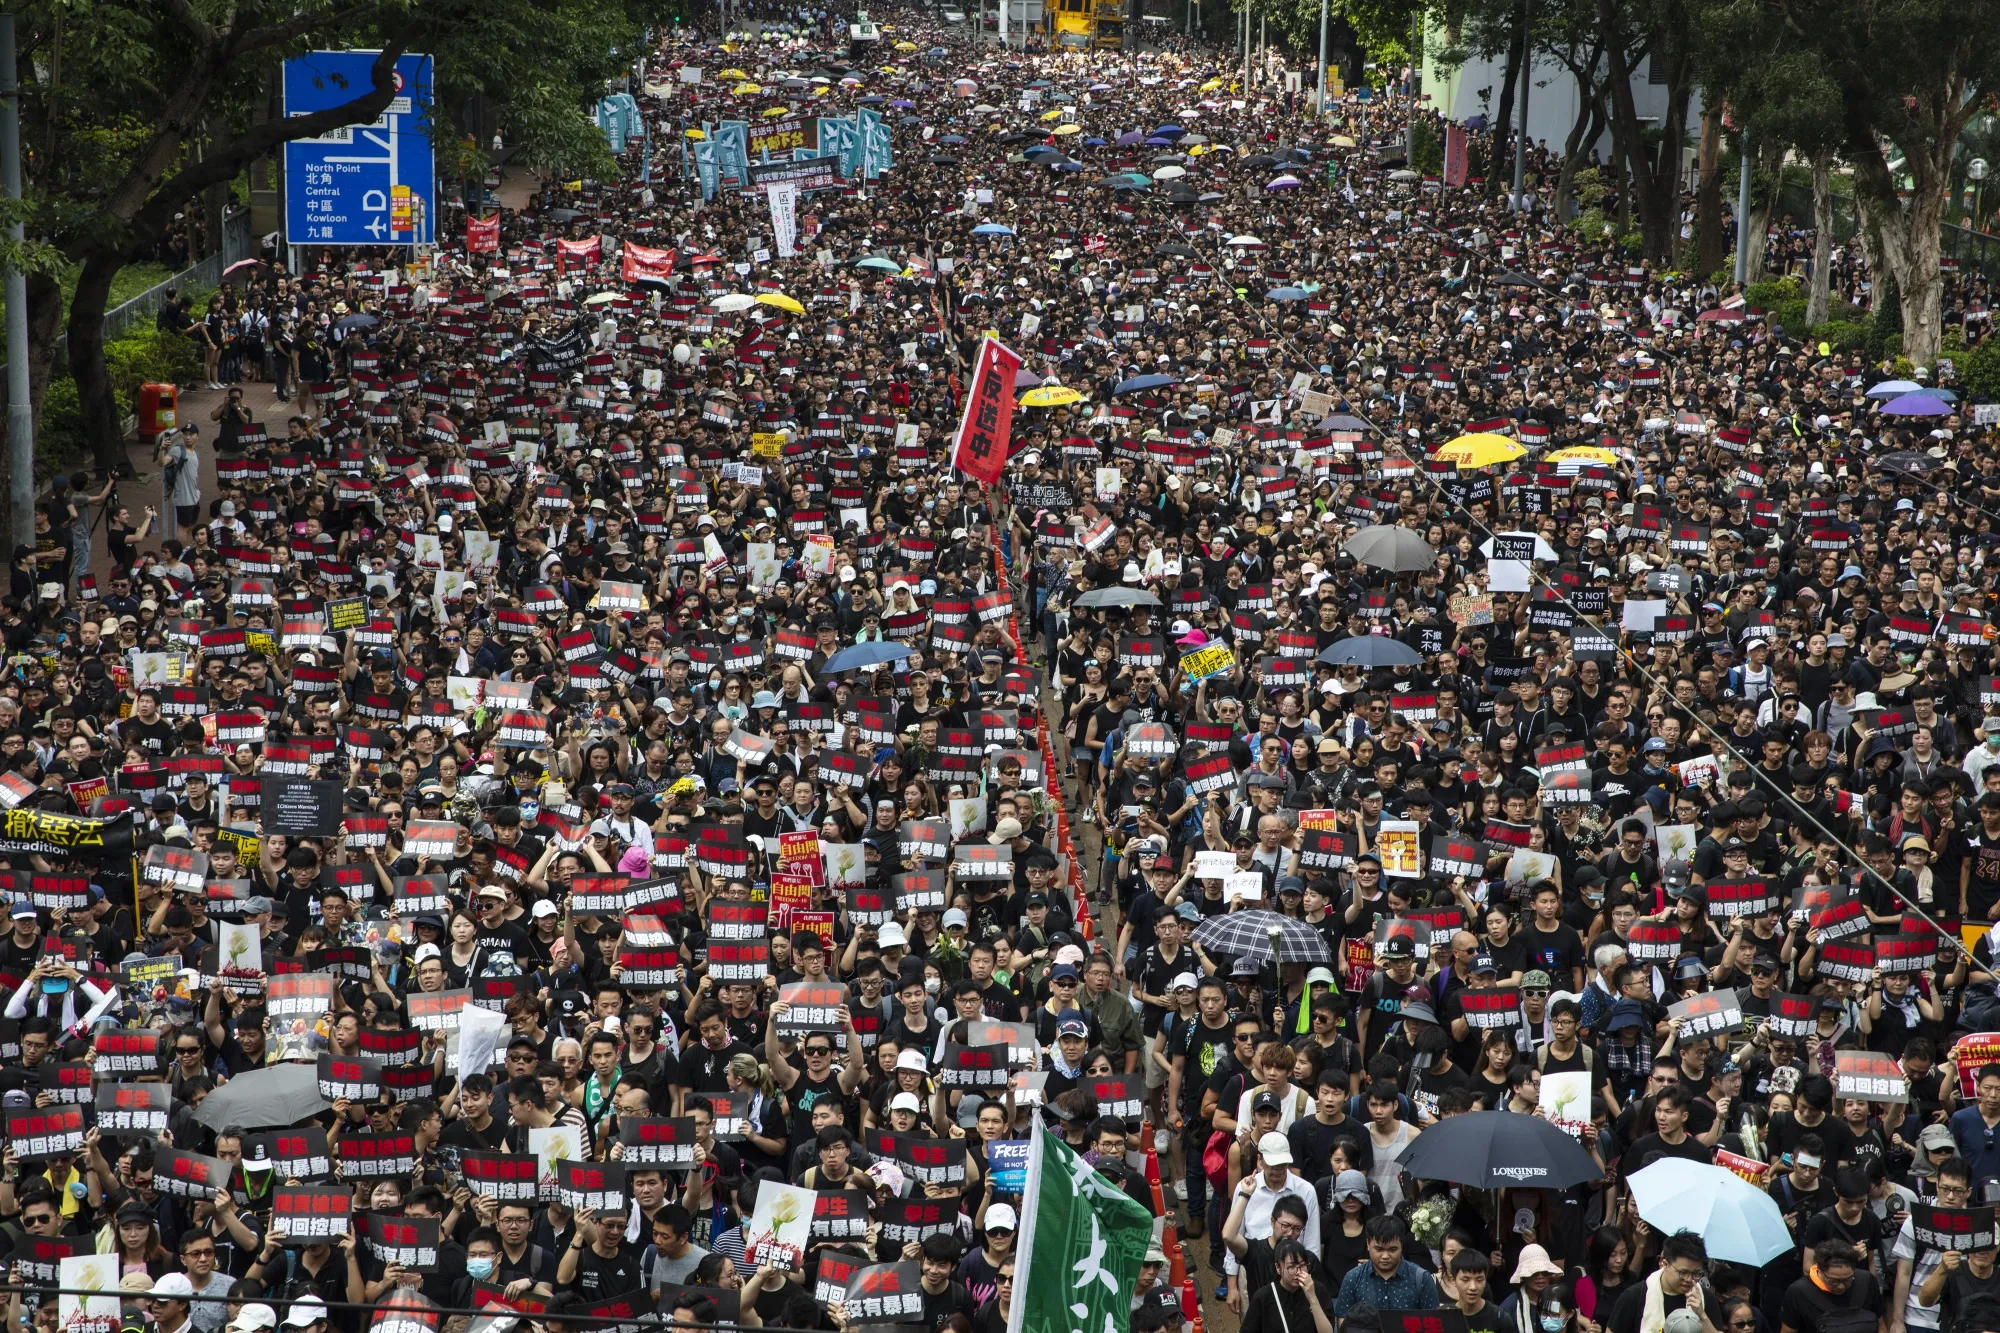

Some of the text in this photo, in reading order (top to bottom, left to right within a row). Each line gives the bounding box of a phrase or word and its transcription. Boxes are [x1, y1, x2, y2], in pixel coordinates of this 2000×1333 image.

[609, 118, 620, 150] 民主黨
[750, 122, 802, 137] 反送中 抗惡法
[305, 164, 360, 173] North Point
[305, 174, 332, 185] 北角
[305, 186, 341, 196] Central
[306, 200, 332, 212] 中區
[306, 213, 347, 222] Kowloon
[307, 226, 333, 238] 九龍
[968, 369, 1002, 462] 反送中
[1474, 480, 1490, 490] NOT
[1496, 550, 1503, 558] A
[1514, 542, 1532, 550] NOT
[1585, 592, 1604, 600] NOT
[1578, 601, 1604, 610] RIOT!!
[1422, 630, 1442, 640] 不撤
[1421, 641, 1441, 652] 不散
[162, 703, 208, 716] 沒有暴動
[218, 727, 264, 740] 撤回控罪
[500, 729, 545, 742] 撤回控罪
[1129, 741, 1175, 753] 沒有暴動
[1604, 782, 1624, 791] NIKE
[4, 809, 104, 846] 撤惡法
[1317, 837, 1344, 853] 學生
[1389, 832, 1416, 841] you hear
[403, 840, 453, 855] 撤回控罪
[956, 862, 1010, 876] 沒有暴動
[1403, 858, 1416, 869] Men
[1430, 858, 1483, 878] 沒有暴動
[1976, 858, 2000, 880] 24
[34, 892, 88, 909] 撤回控罪
[395, 896, 446, 912] 沒有暴動
[896, 892, 944, 908] 沒有暴動
[710, 924, 765, 939] 撤回控罪
[1628, 943, 1681, 958] 撤回控罪
[709, 963, 767, 979] 撤回控罪
[1878, 954, 1936, 972] 撤回控罪
[619, 969, 679, 985] 撤回控罪
[268, 998, 329, 1016] 撤回控罪
[777, 1007, 841, 1024] 撤回控罪
[1464, 1012, 1520, 1029] 撤回控罪
[1679, 1009, 1742, 1038] 沒有暴動
[95, 1035, 157, 1052] 問責槍擊
[959, 1052, 992, 1067] 學生
[942, 1068, 1008, 1085] 沒有暴動
[1094, 1083, 1127, 1099] 學生
[1839, 1076, 1906, 1096] 撤回控罪
[116, 1089, 150, 1107] 學生
[1098, 1099, 1142, 1118] 有暴動
[97, 1111, 168, 1130] 沒有暴動
[639, 1124, 676, 1142] 學生
[11, 1132, 84, 1157] 撤回控罪
[277, 1137, 308, 1156] 學生
[911, 1145, 947, 1164] 學生
[173, 1157, 211, 1182] 學生
[343, 1158, 415, 1177] 撤回控罪
[1493, 1167, 1548, 1176] LONGINES
[570, 1168, 604, 1189] 學生
[274, 1194, 349, 1213] 問責槍擊
[813, 1197, 848, 1216] 學生
[904, 1205, 941, 1222] 學生
[1931, 1213, 1971, 1231] 學生
[274, 1217, 348, 1237] 撤回控罪
[382, 1223, 418, 1244] 學生
[883, 1223, 956, 1242] 沒有暴動
[1915, 1226, 1993, 1250] 沒有暴動
[756, 1243, 793, 1262] 反送中
[862, 1271, 900, 1293] 學生
[845, 1292, 923, 1319] 沒有暴動
